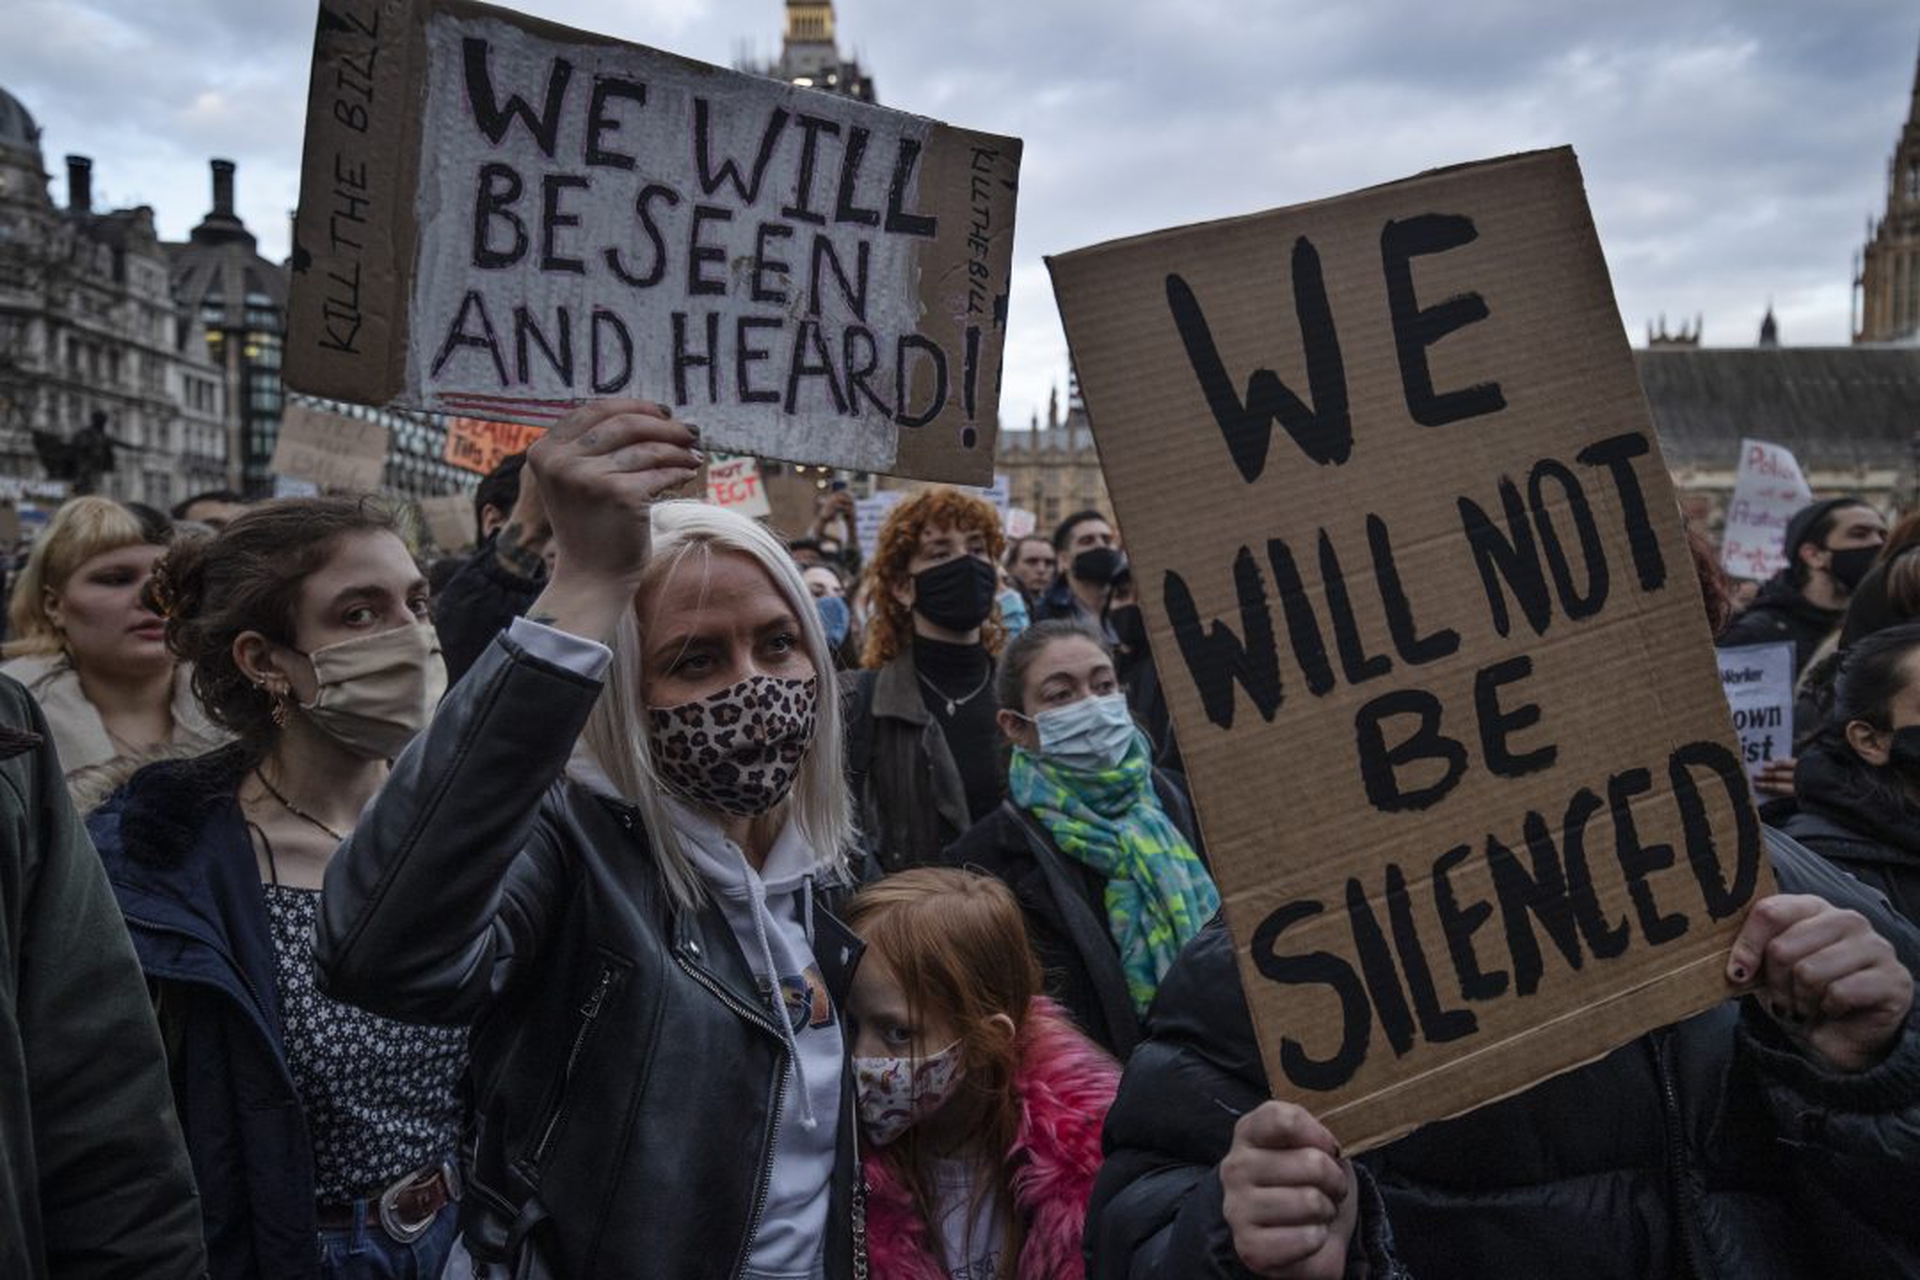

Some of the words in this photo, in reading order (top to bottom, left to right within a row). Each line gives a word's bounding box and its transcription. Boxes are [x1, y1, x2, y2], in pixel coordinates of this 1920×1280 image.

[333, 9, 379, 133] BILL
[462, 37, 646, 170] WE
[694, 96, 938, 238] WILL
[970, 146, 1000, 202] KILL
[330, 153, 370, 258] THE
[472, 162, 590, 274] BE
[603, 183, 870, 323] SEEN
[967, 205, 990, 261] THE
[318, 260, 362, 355] KILL
[966, 258, 989, 314] BILL
[430, 289, 634, 394] AND
[671, 311, 982, 449] HEARD!
[1165, 212, 1508, 485] WE
[1163, 512, 1462, 730] WILL
[1456, 431, 1667, 639] NOT
[1354, 654, 1558, 813] BE
[1733, 704, 1782, 731] own
[1741, 734, 1774, 763] ist
[1250, 740, 1762, 1092] SILENCED
